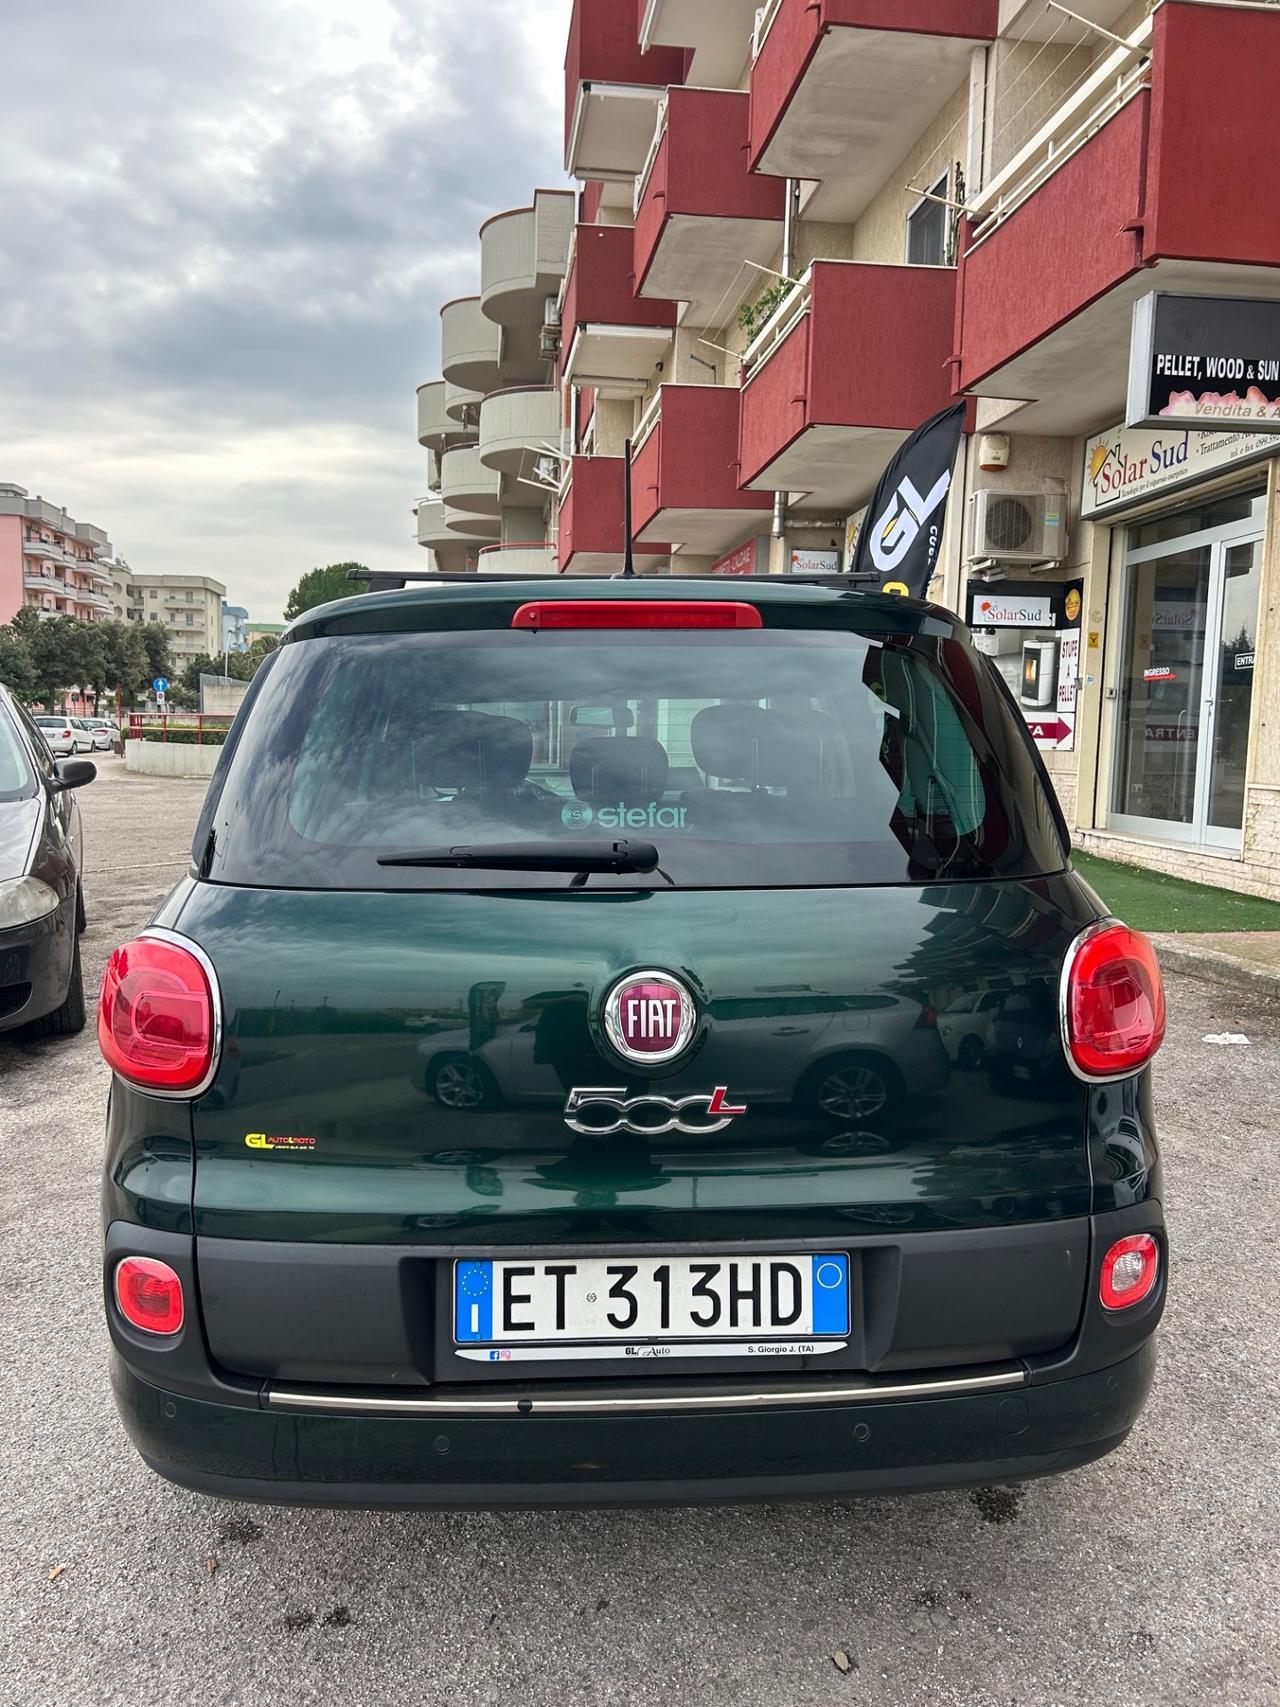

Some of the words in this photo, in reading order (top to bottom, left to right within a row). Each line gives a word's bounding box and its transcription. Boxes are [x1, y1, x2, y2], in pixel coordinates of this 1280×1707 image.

[1156, 354, 1202, 380] PELLET,
[1206, 357, 1244, 379] WOOD
[1246, 365, 1255, 379] &
[1257, 360, 1280, 381] SUN
[1194, 403, 1252, 417] Vendita
[1256, 405, 1266, 418] &
[1101, 451, 1147, 494] Solar
[1150, 431, 1188, 474] Sud
[796, 560, 837, 571] SolarSud
[987, 608, 1042, 621] SolarSud
[597, 801, 688, 828] stefar
[627, 999, 677, 1038] FIAT
[564, 1086, 747, 1135] 500L
[245, 1133, 275, 1149] GL
[503, 1265, 577, 1331] ET
[606, 1262, 803, 1329] 313HD
[625, 1347, 637, 1355] GL
[643, 1346, 671, 1357] Auto
[757, 1345, 787, 1354] Giorgio
[789, 1345, 797, 1353] J.
[797, 1345, 814, 1353] (TA)
